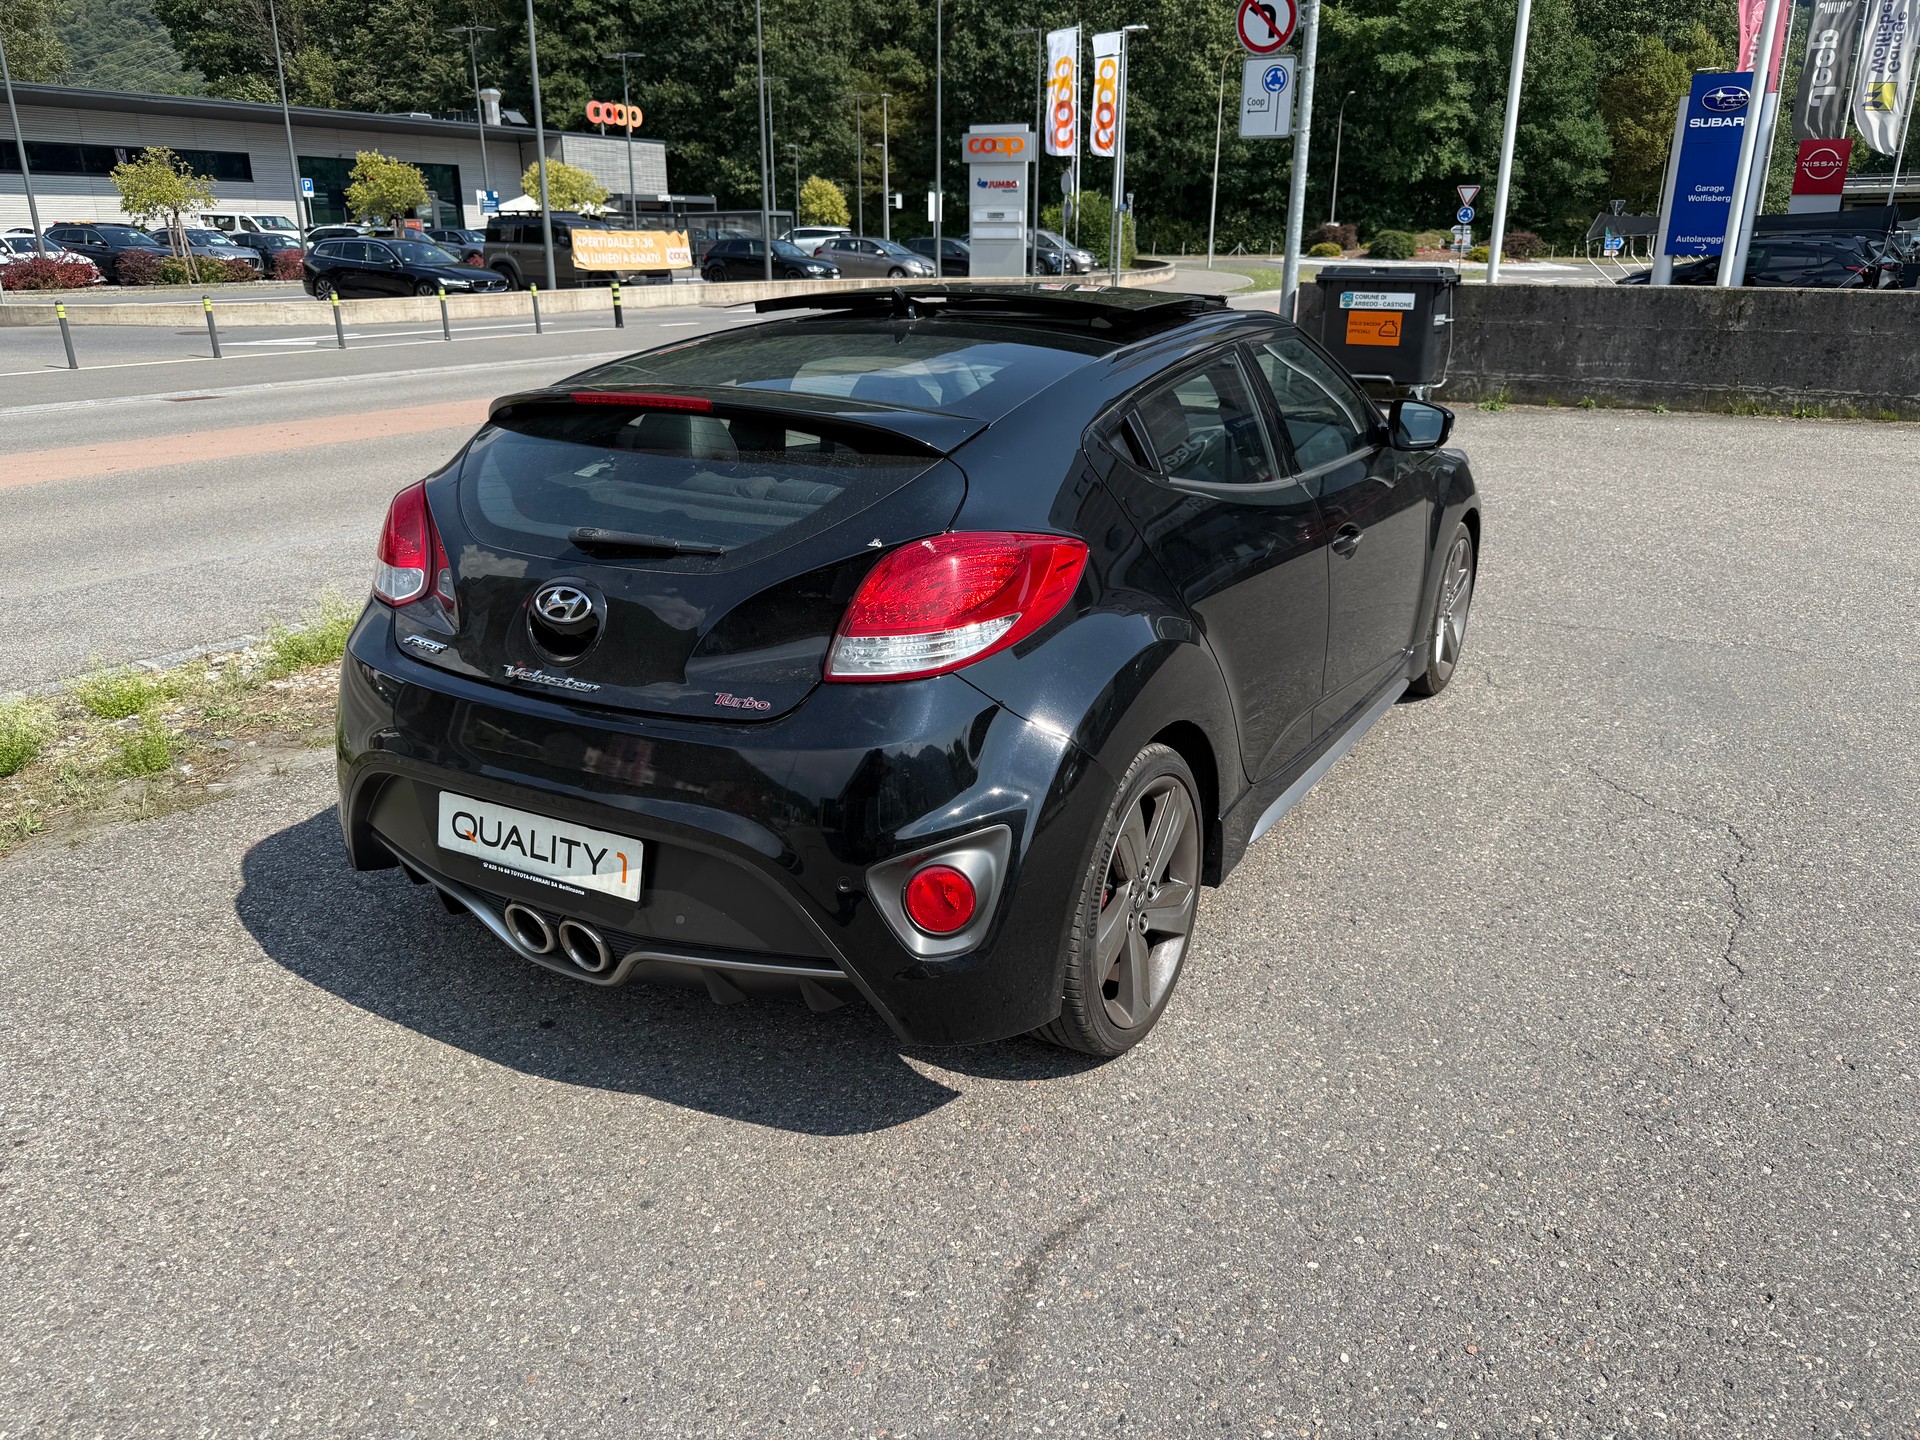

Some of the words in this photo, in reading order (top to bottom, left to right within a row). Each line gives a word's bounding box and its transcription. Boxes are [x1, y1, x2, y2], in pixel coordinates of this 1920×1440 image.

[1246, 97, 1265, 108] Coop
[586, 100, 643, 133] coop
[1689, 116, 1746, 128] SUBAR
[968, 136, 1025, 158] coop
[987, 180, 1018, 189] JUMBO
[1694, 184, 1725, 194] Garage
[1687, 194, 1731, 203] Wolfisberg
[576, 236, 607, 248] APERTI
[609, 237, 635, 248] DALLE
[636, 237, 653, 248] 7.30
[1675, 235, 1725, 244] Autolavaggi
[623, 253, 629, 263] A
[503, 664, 601, 692] Veloster
[714, 692, 771, 711] Turbo
[452, 811, 608, 875] QUALITY
[510, 869, 550, 886] TOYOTA-FERRARI
